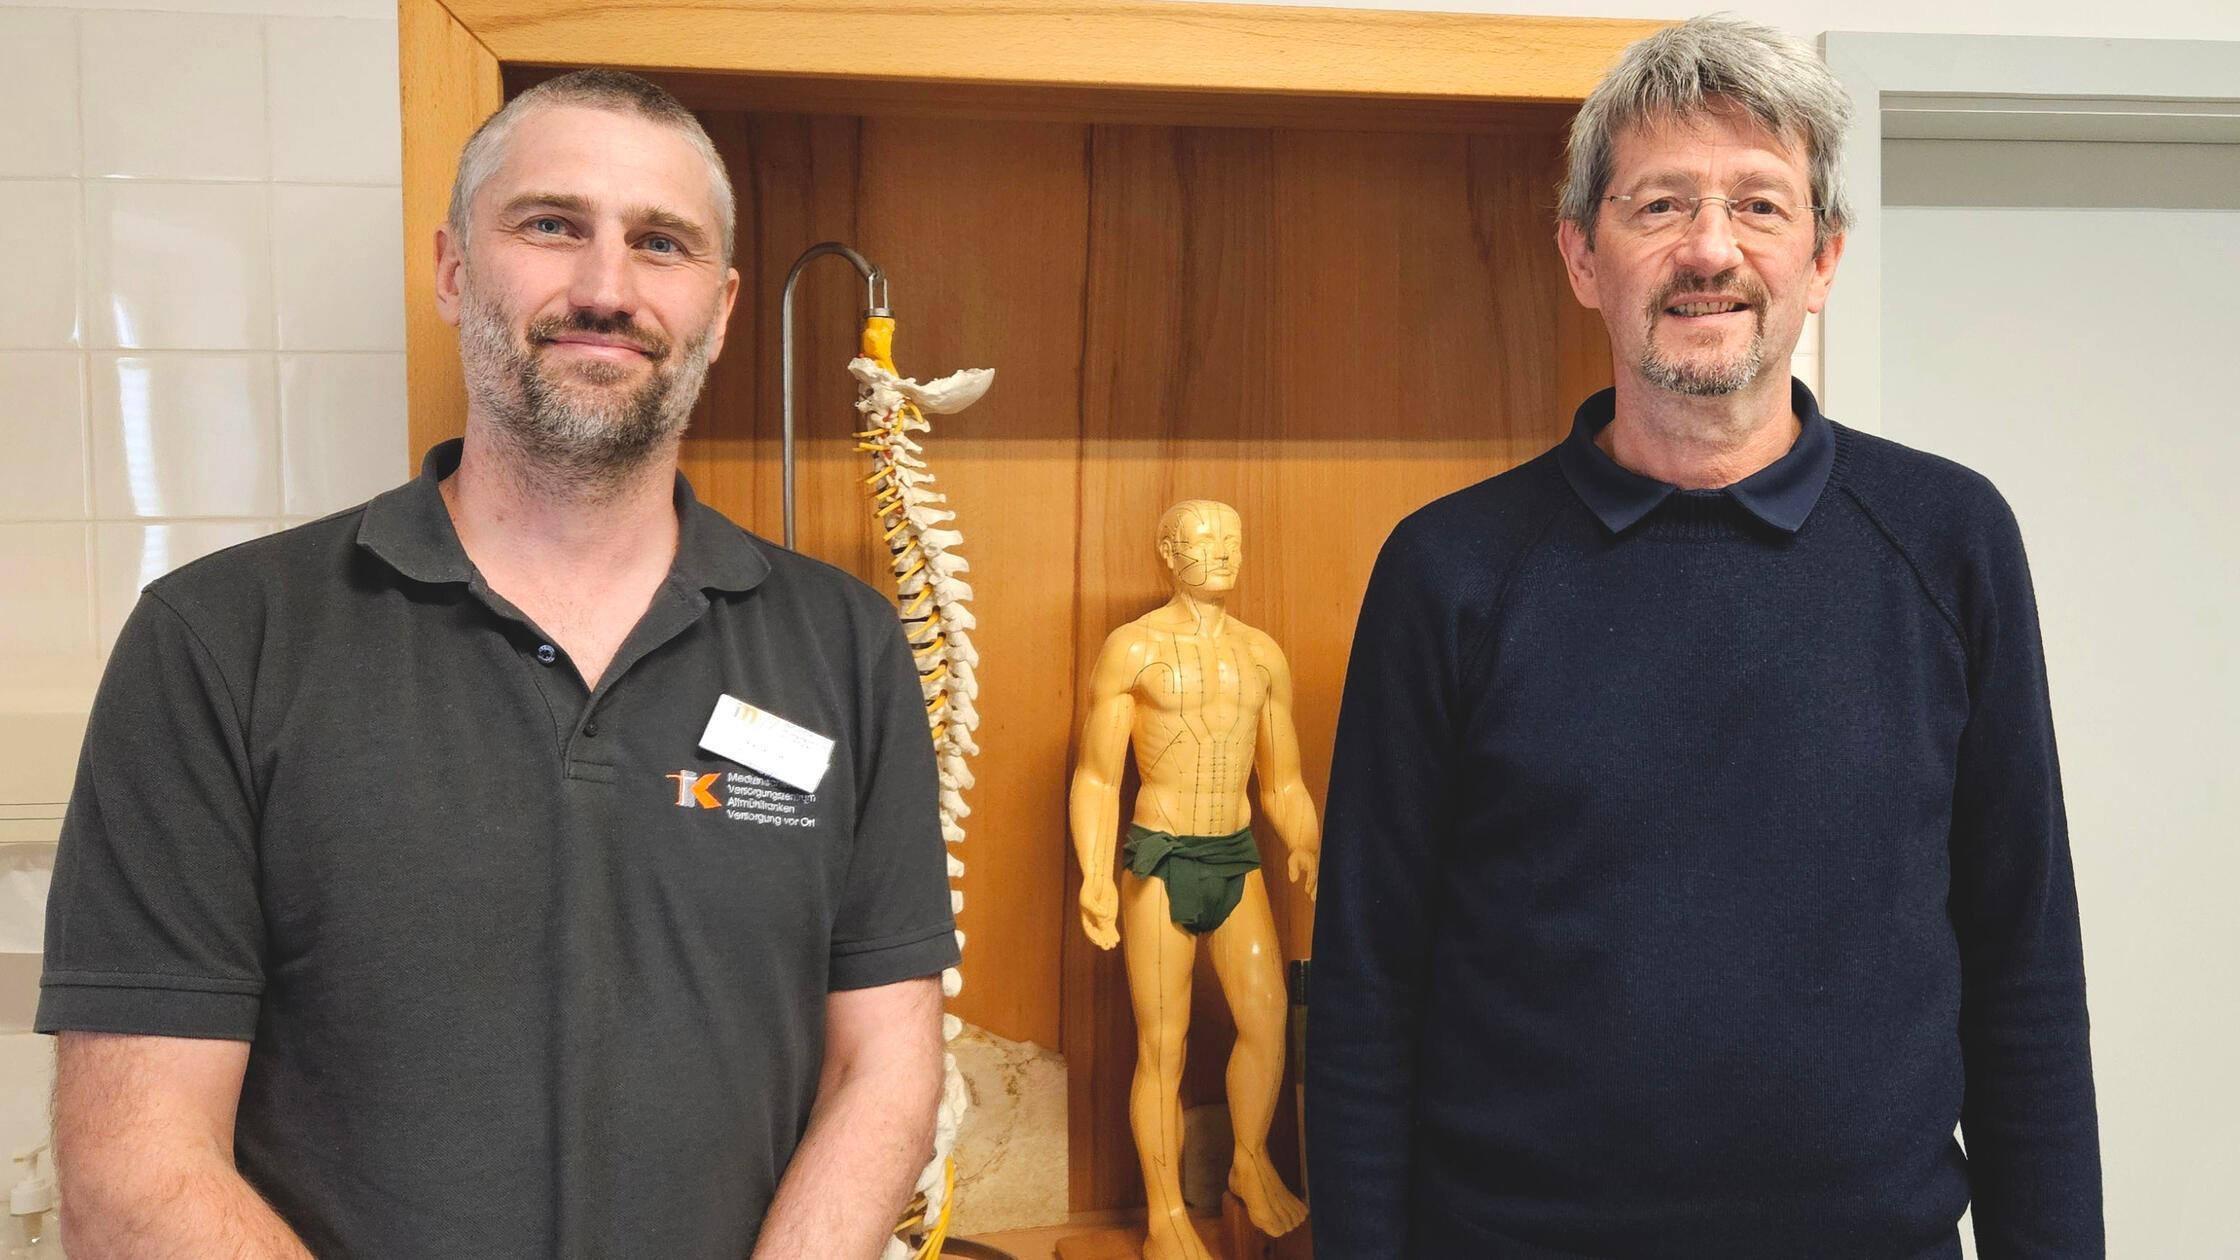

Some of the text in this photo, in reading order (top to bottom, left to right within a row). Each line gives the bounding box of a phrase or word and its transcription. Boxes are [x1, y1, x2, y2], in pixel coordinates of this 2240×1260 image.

[726, 796, 796, 814] Altmühlfranken
[726, 809, 816, 827] Versorgung vor Ort
